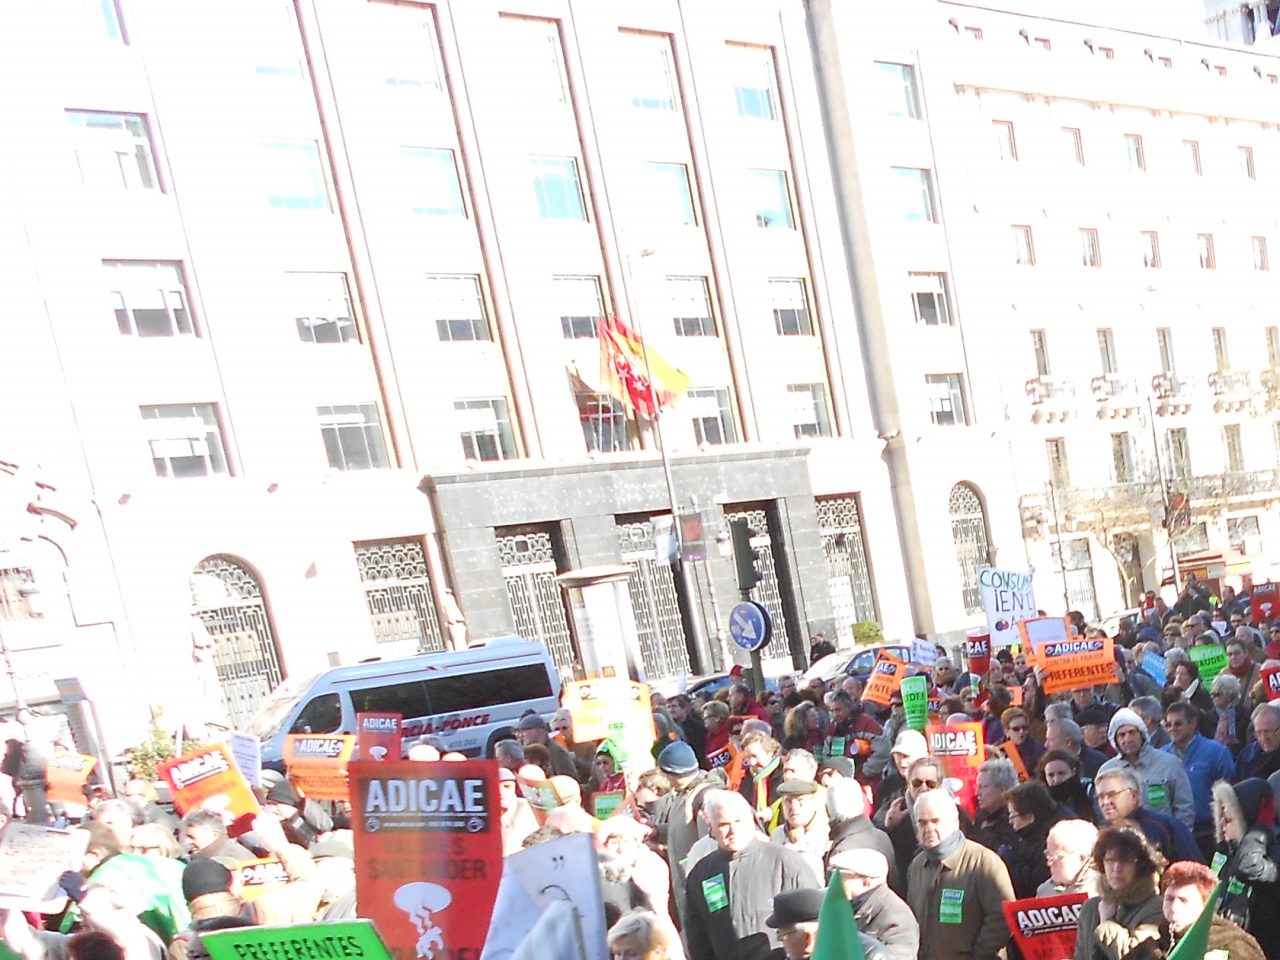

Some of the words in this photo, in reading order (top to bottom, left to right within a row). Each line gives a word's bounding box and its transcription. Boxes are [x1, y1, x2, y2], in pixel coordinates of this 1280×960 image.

[1055, 641, 1094, 653] ADICAE
[363, 718, 398, 729] ADICAE
[365, 779, 485, 813] ADICAE
